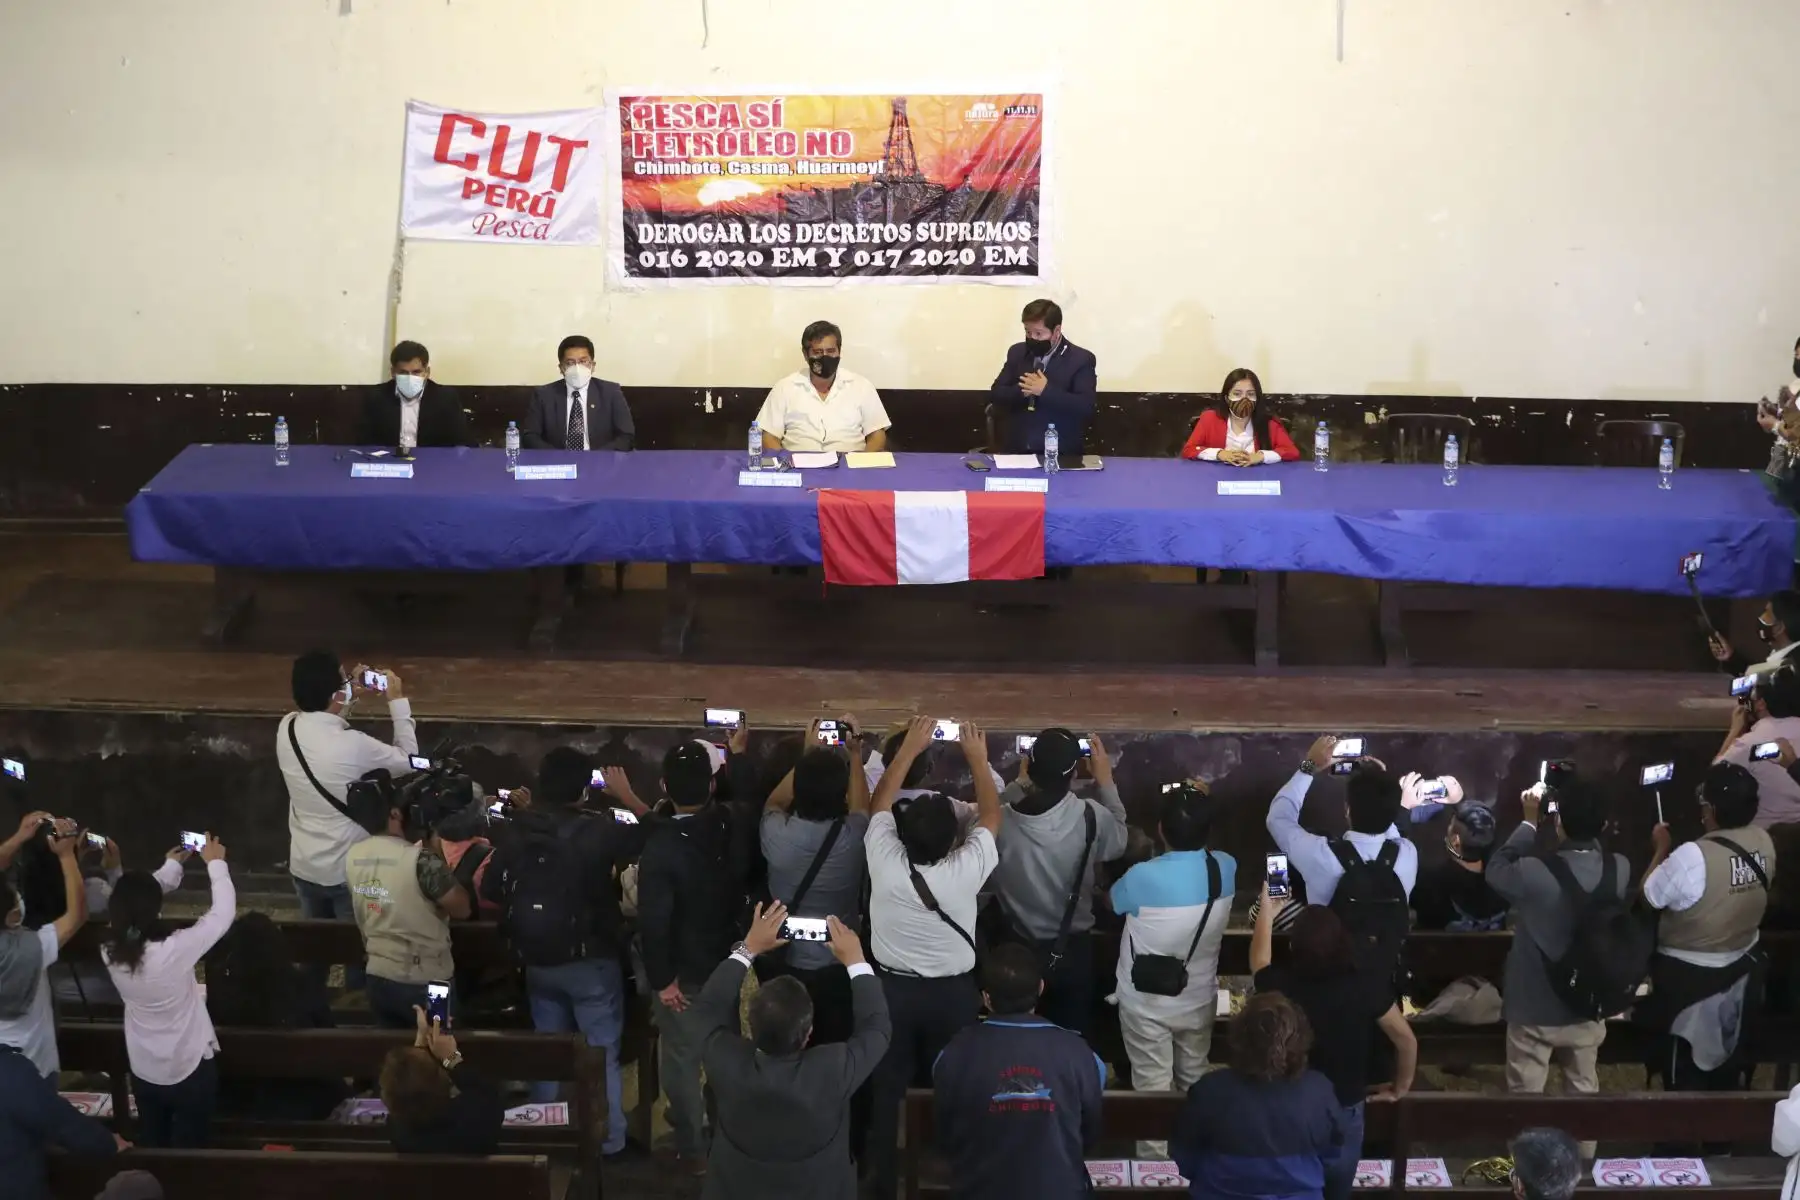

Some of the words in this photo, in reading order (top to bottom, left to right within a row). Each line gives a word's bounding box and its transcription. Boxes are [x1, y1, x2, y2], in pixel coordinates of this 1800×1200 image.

[631, 103, 740, 129] PESCA
[748, 98, 783, 128] SÍ
[433, 113, 588, 193] CUT
[632, 127, 797, 158] PETRÓLEO
[805, 130, 853, 158] NO
[634, 160, 726, 176] Chimbote,
[727, 160, 795, 176] Casma,
[796, 160, 886, 175] Huarmey!
[461, 177, 557, 220] PERÚ
[472, 212, 551, 241] Pesca
[637, 222, 745, 244] DEROGAR
[749, 223, 791, 244] LOS
[795, 222, 912, 244] DECRETOS
[915, 221, 1032, 243] SUPREMOS
[638, 249, 689, 268] 016
[695, 250, 764, 268] 2020
[771, 247, 818, 268] EM
[823, 247, 847, 267] Y
[854, 249, 903, 269] 017
[909, 248, 976, 267] 2020
[982, 245, 1030, 266] EM
